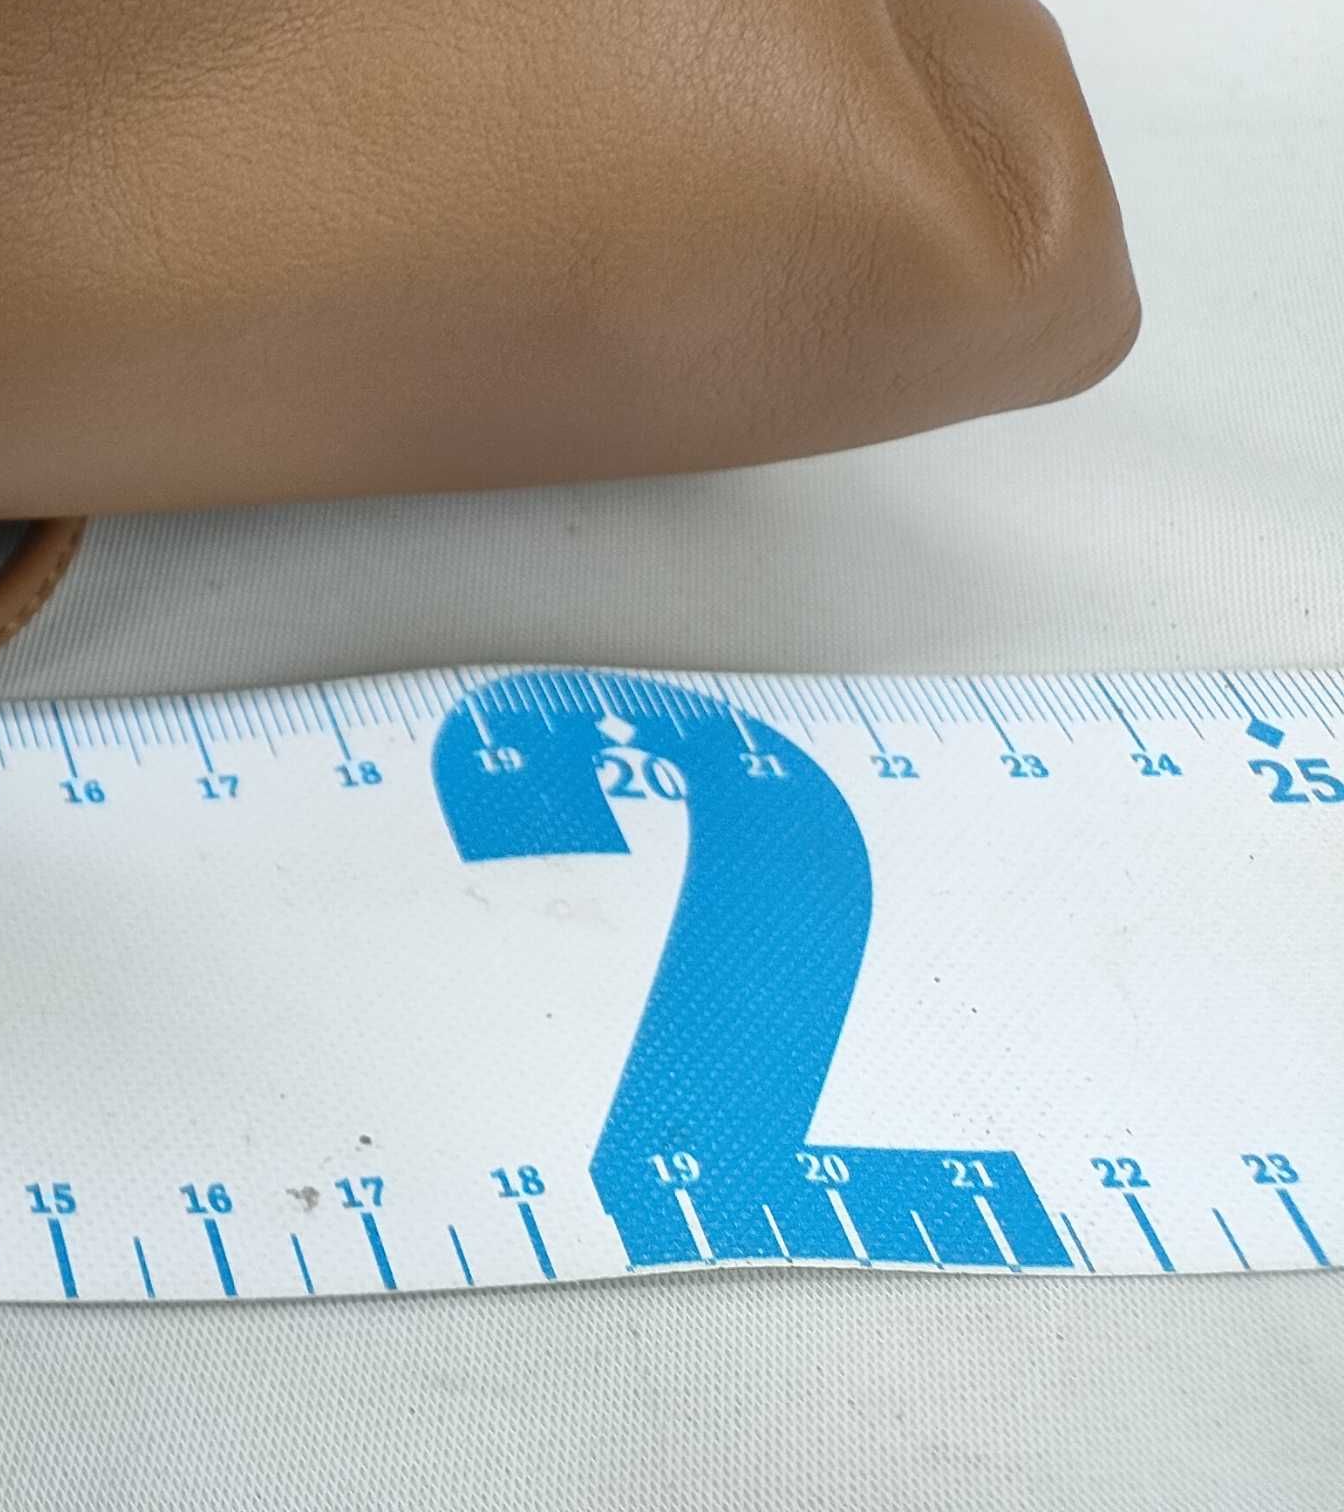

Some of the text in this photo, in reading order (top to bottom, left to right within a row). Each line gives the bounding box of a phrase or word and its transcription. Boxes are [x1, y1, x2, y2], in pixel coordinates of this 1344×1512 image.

[59, 779, 105, 805] 16
[197, 775, 240, 800] 17
[334, 760, 383, 788] 18
[474, 745, 525, 774] 19
[594, 752, 687, 802] 20
[738, 753, 790, 778] 21
[870, 754, 919, 780] 22
[1000, 753, 1049, 779] 23
[1130, 752, 1182, 777] 24
[1248, 758, 1344, 805] 25
[431, 666, 1075, 1270] 2
[25, 1183, 78, 1216] 15
[179, 1183, 234, 1215] 16
[334, 1176, 386, 1210] 17
[490, 1165, 547, 1200] 18
[647, 1151, 701, 1185] 19
[796, 1151, 849, 1185] 20
[942, 1158, 998, 1189] 21
[1091, 1158, 1151, 1190] 22
[1241, 1153, 1300, 1186] 23
